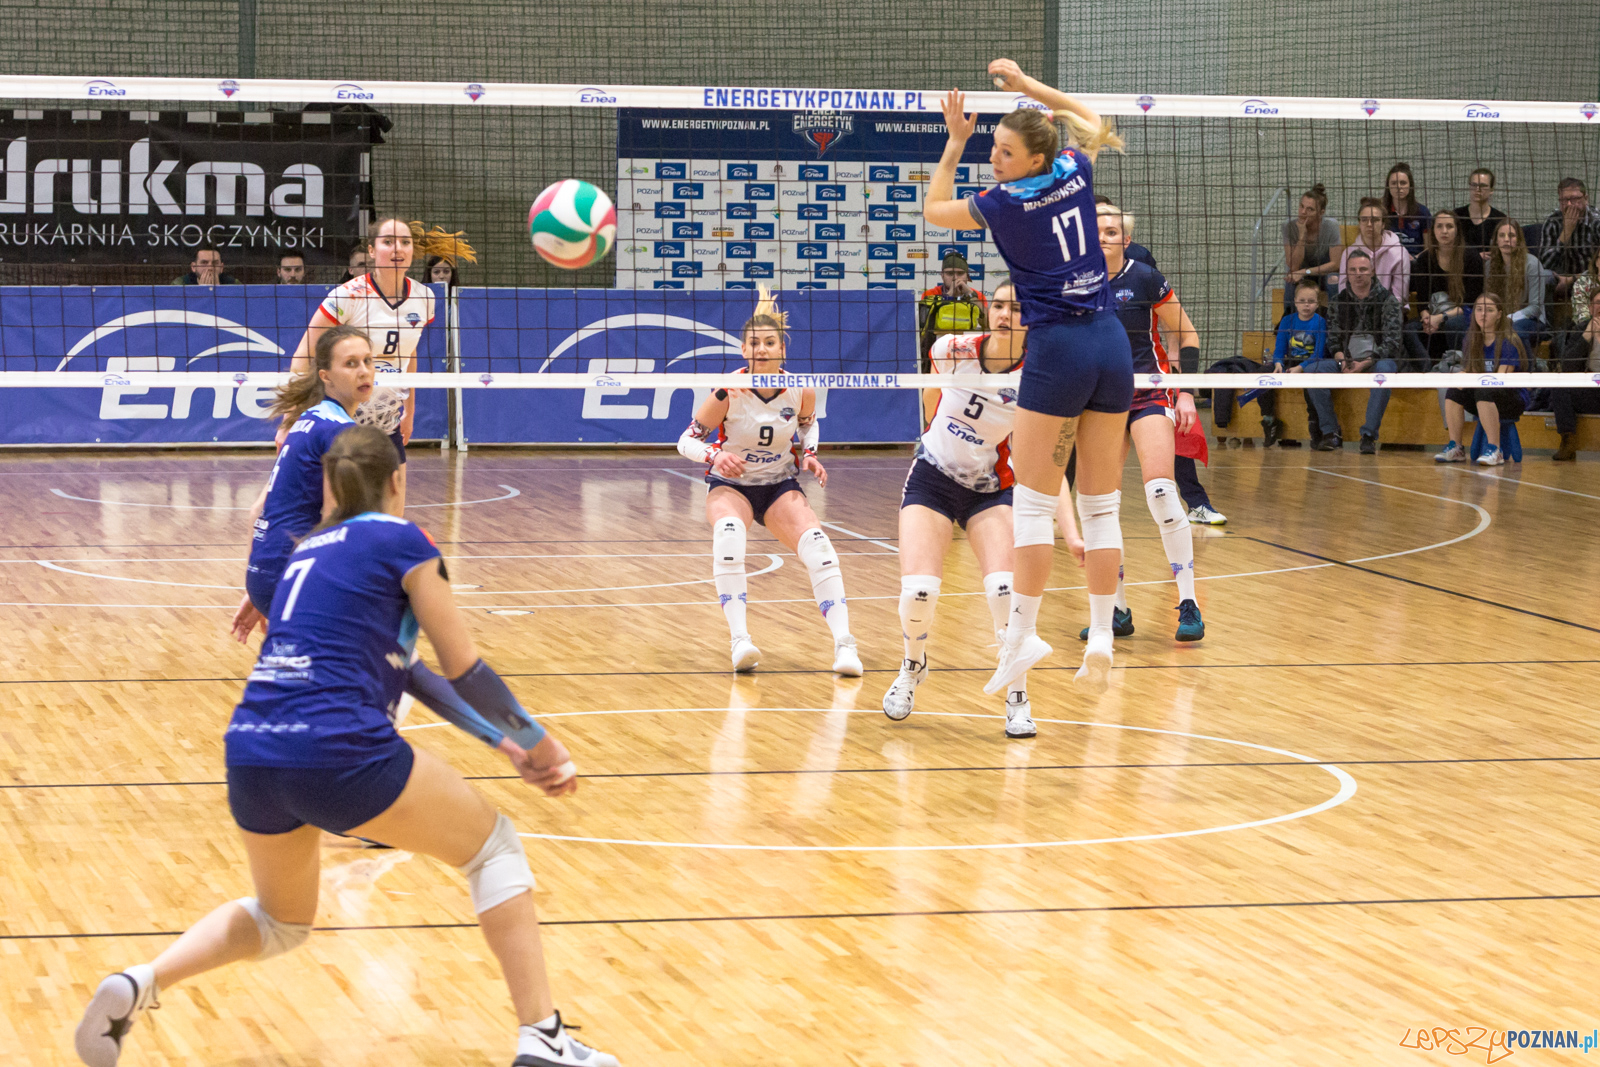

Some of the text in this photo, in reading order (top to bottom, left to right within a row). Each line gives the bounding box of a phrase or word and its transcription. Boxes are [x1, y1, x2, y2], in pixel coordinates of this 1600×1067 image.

[88, 87, 126, 96] Enea
[337, 90, 374, 100] Enea
[581, 94, 617, 103] Enea
[704, 88, 926, 110] ENERGETYKPOZNAN.PL
[1245, 105, 1279, 115] Enea
[1466, 109, 1500, 119] Enea
[642, 119, 770, 130] WWW.ENERGETYKPOZNAN.PL
[794, 115, 852, 130] ENERGETYK
[147, 220, 324, 248] SKOCZYŃSKI
[1052, 206, 1086, 262] 17
[383, 331, 399, 354] 8
[99, 357, 278, 419] Ene
[752, 375, 901, 387] ENERGETYKPOZNAN.PL
[963, 393, 988, 420] 5
[758, 426, 774, 447] 9
[947, 422, 984, 446] Enea
[745, 453, 781, 464] Enea
[281, 557, 316, 621] 7
